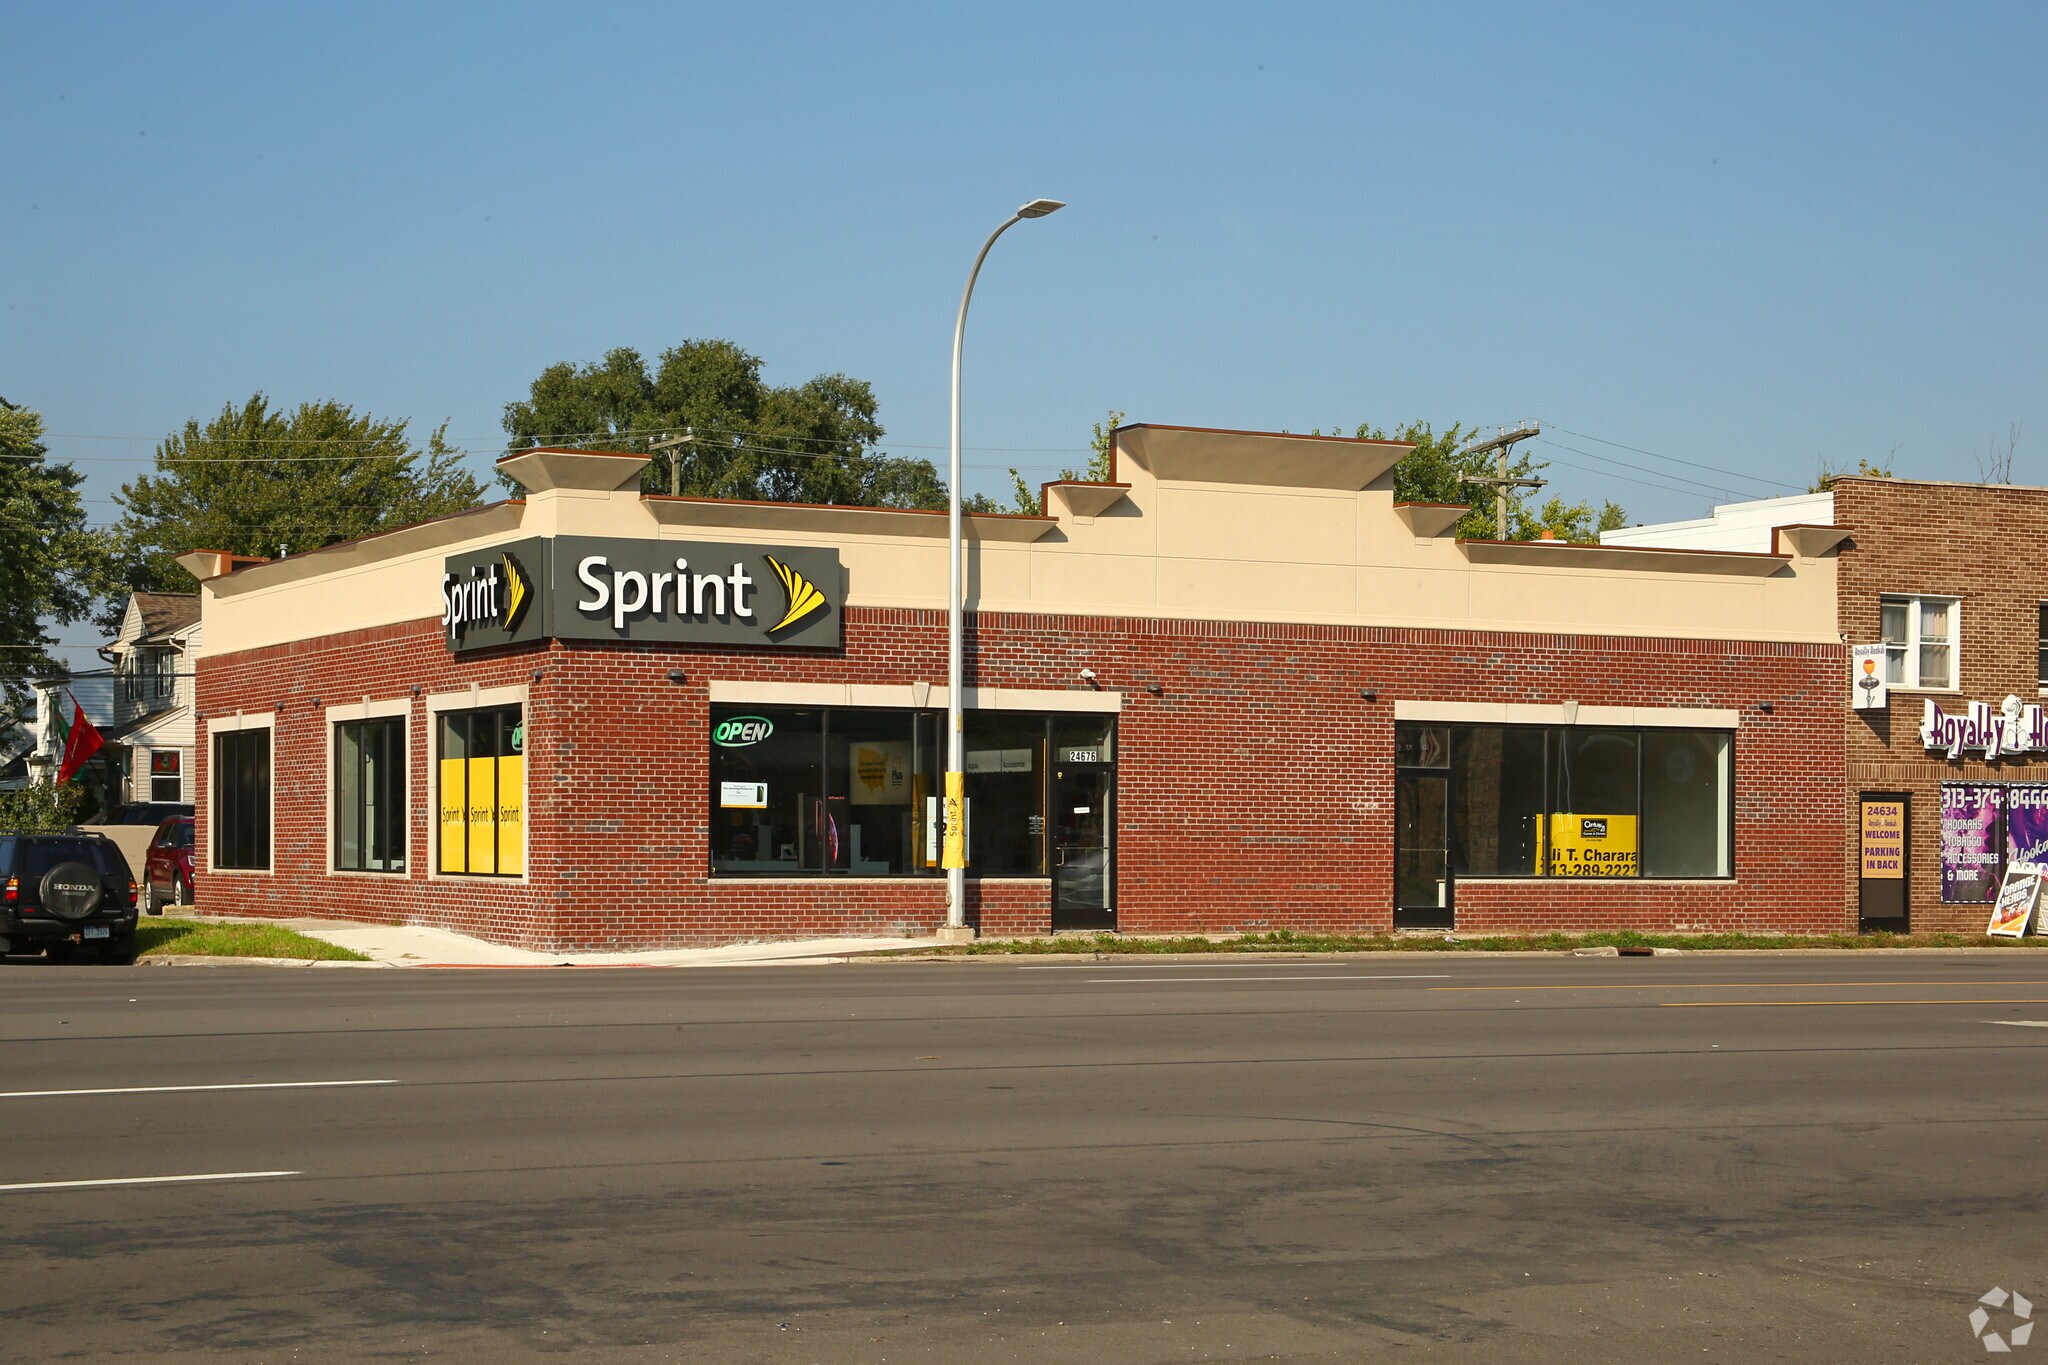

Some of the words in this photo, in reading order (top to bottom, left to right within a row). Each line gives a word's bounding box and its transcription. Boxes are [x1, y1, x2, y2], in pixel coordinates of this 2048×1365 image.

[578, 555, 752, 629] Sprint
[441, 563, 498, 639] Sprint
[716, 722, 767, 741] OPEN
[1930, 704, 2005, 756] Royalty
[1070, 751, 1096, 761] 24676
[442, 806, 460, 827] Sprint
[470, 806, 489, 827] Sprint
[500, 805, 519, 827] Sprint
[1867, 806, 1897, 816] 24634
[1947, 819, 1983, 830] HOOKAHS
[1865, 830, 1900, 839] WELCOME
[1947, 836, 1982, 847] TOBACCO
[1566, 848, 1578, 861] T.
[1583, 848, 1637, 861] Charara
[1864, 847, 1900, 856] PARKING
[1866, 860, 1875, 869] IN
[1877, 860, 1898, 869] BACK
[1947, 853, 1999, 864] ACCESSORIES
[1947, 869, 1954, 881] &
[1956, 869, 1979, 881] MORE
[53, 883, 96, 892] HONDA
[2004, 875, 2036, 895] ORANGE
[2001, 889, 2028, 907] HEADS
